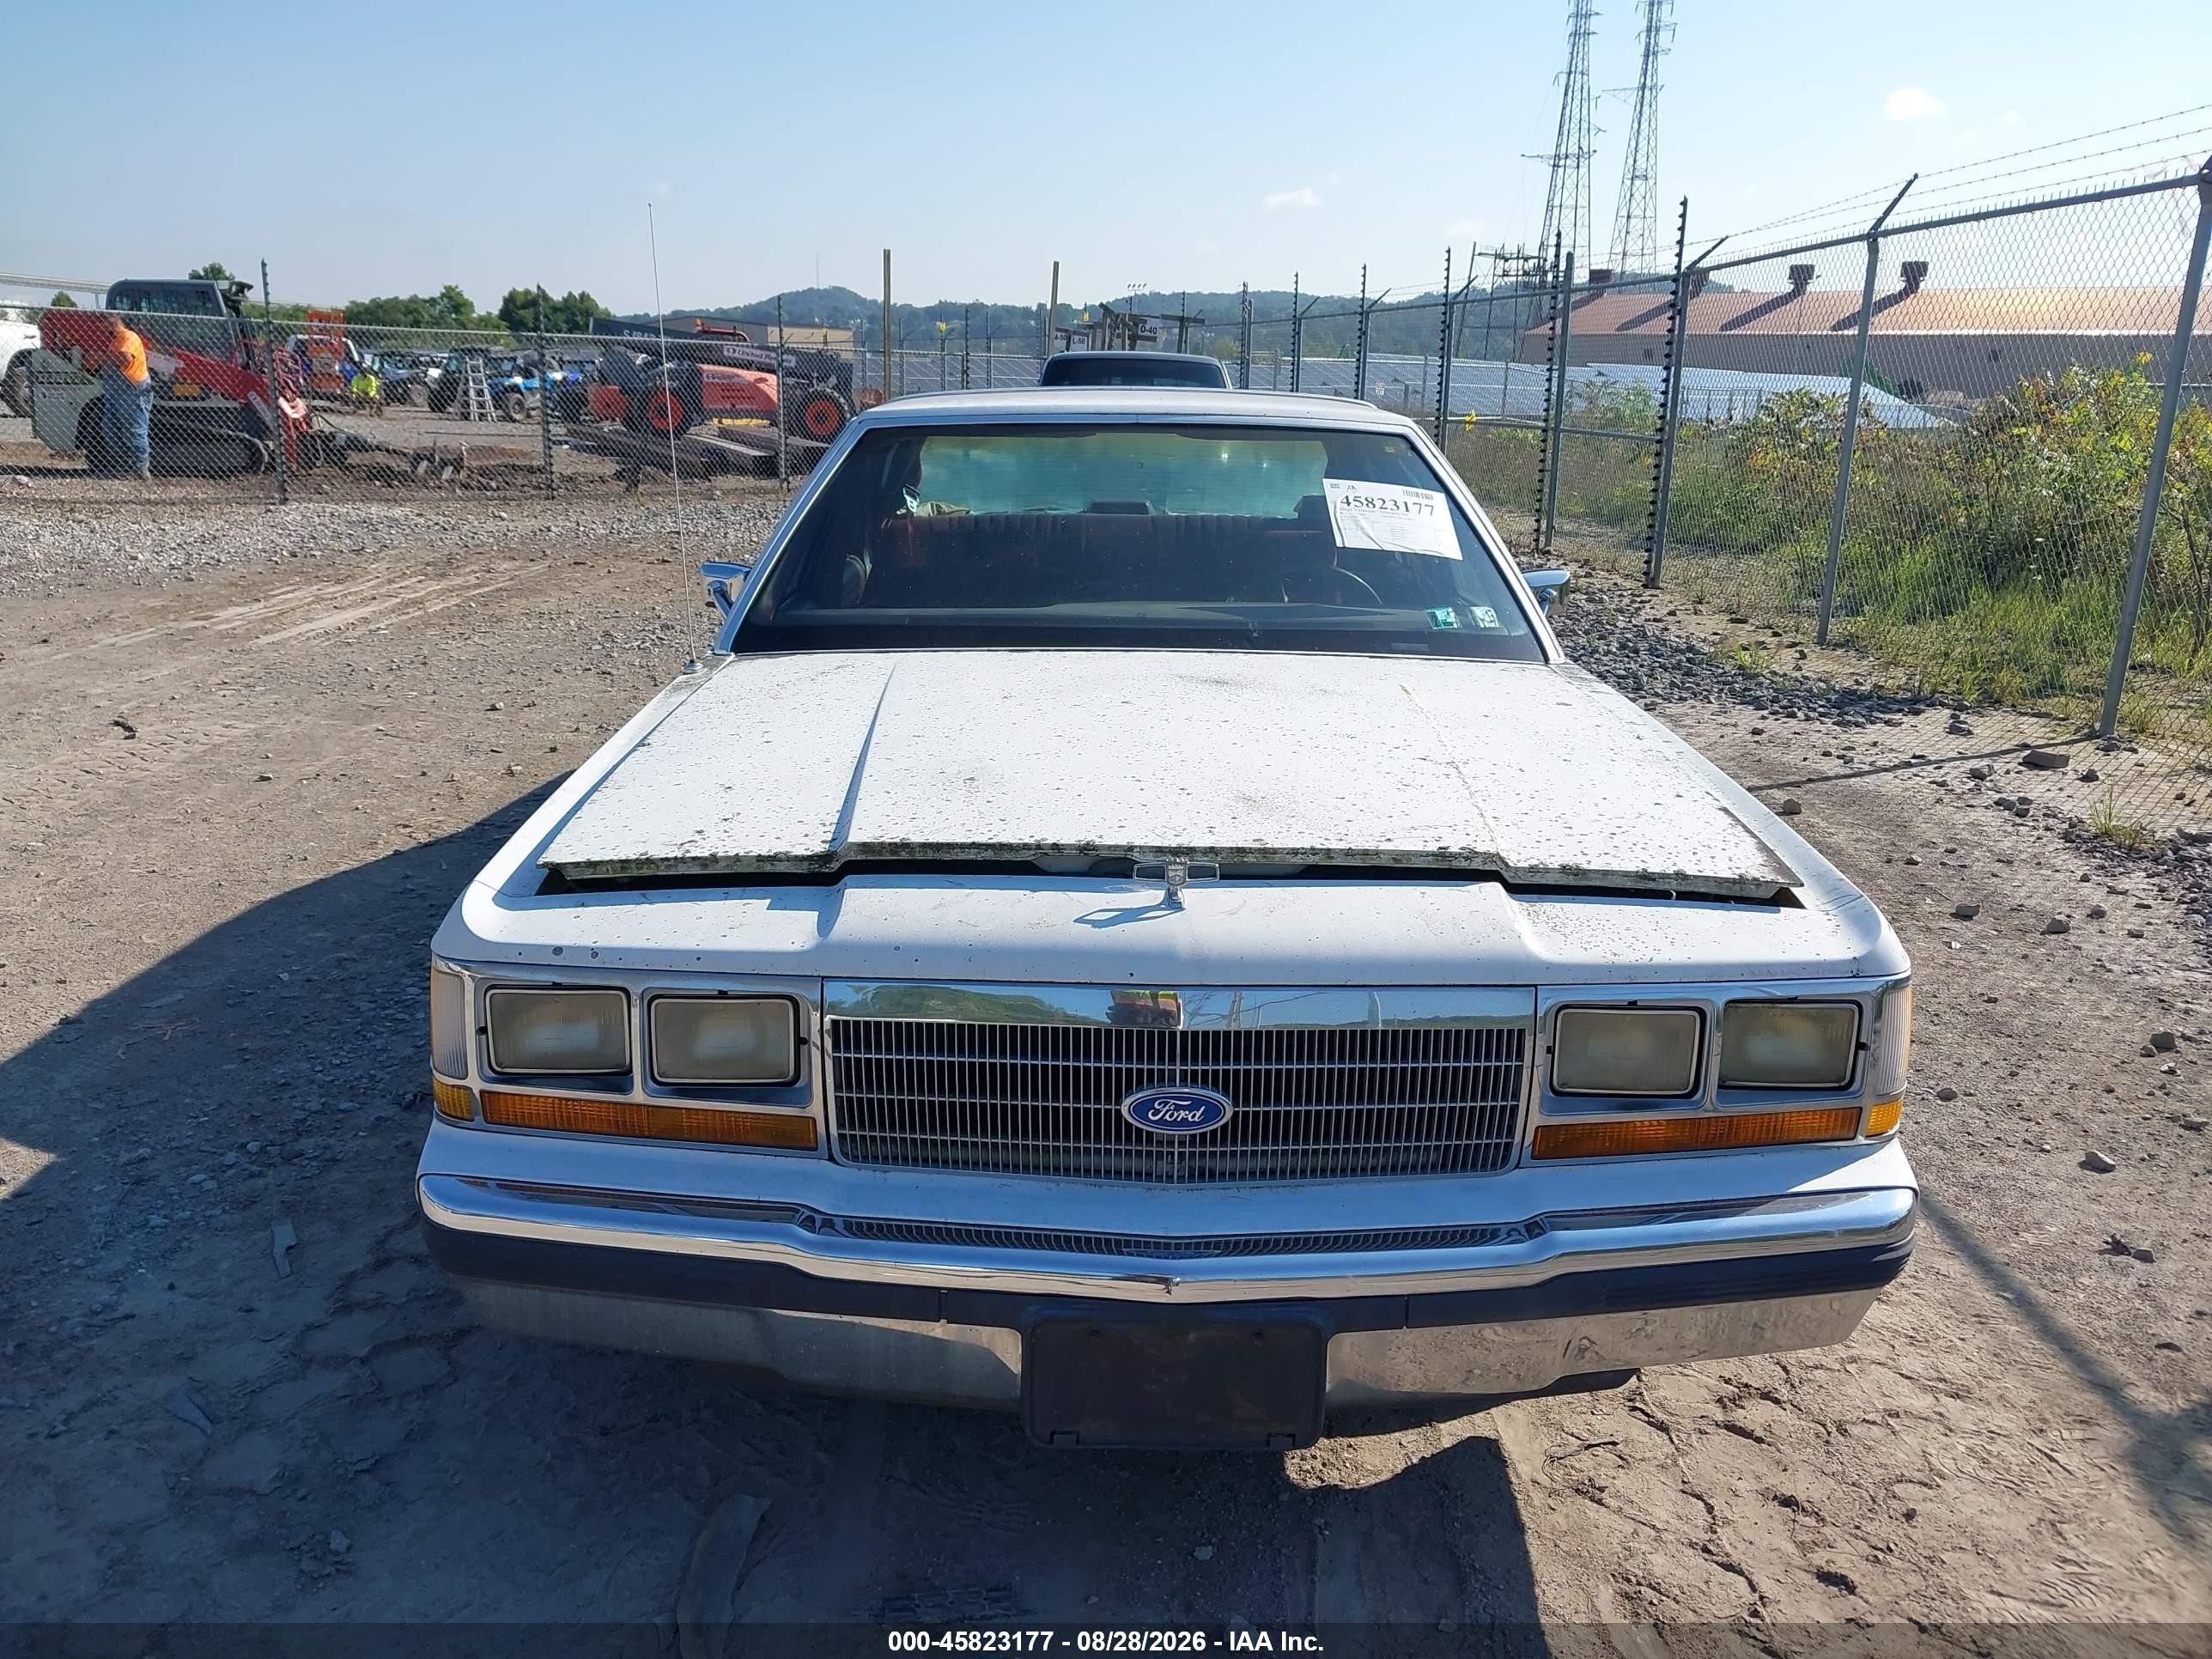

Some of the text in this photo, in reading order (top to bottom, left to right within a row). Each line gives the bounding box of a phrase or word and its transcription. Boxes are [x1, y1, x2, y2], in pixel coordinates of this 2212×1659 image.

[1140, 325, 1158, 335] O-40
[1340, 495, 1434, 516] 45823177
[1148, 1099, 1206, 1122] Ford
